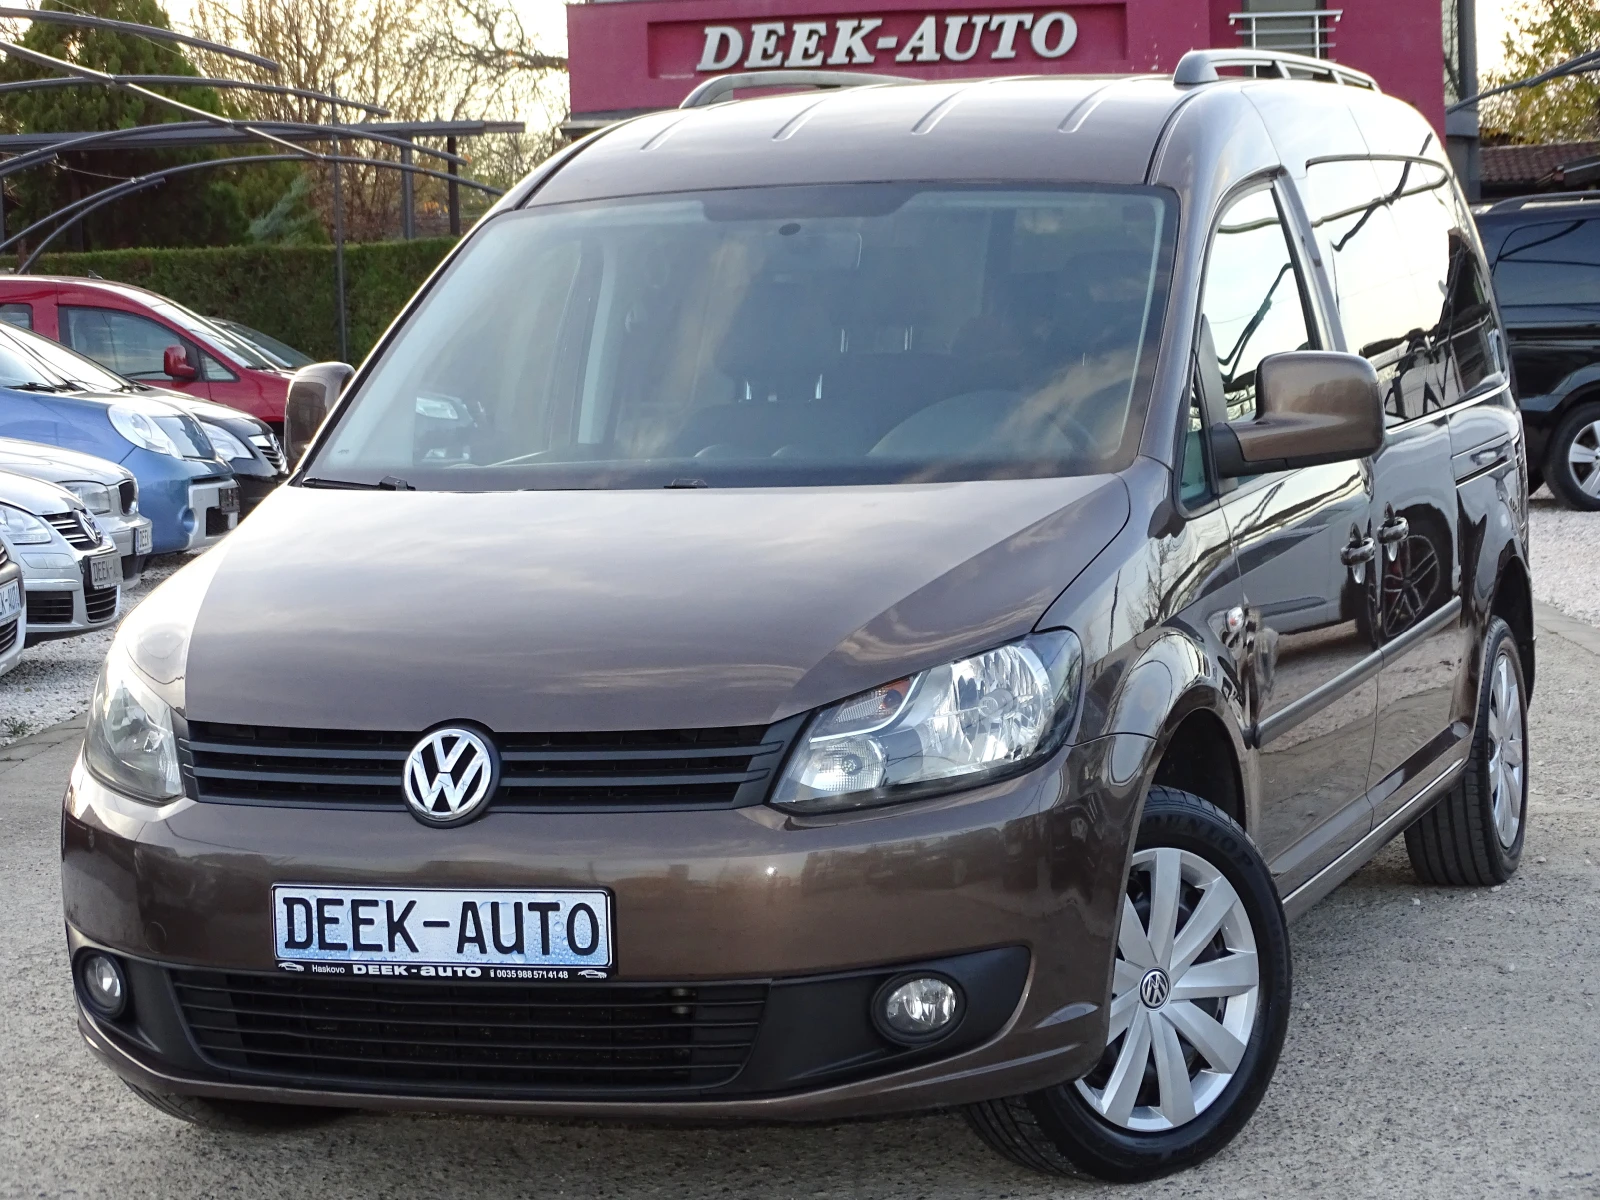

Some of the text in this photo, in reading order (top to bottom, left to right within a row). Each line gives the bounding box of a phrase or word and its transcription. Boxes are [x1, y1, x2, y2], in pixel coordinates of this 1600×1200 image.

[696, 12, 1078, 71] DEEK-AUTO
[283, 896, 600, 956] DEEK-AUTO
[312, 963, 345, 975] Haskovo
